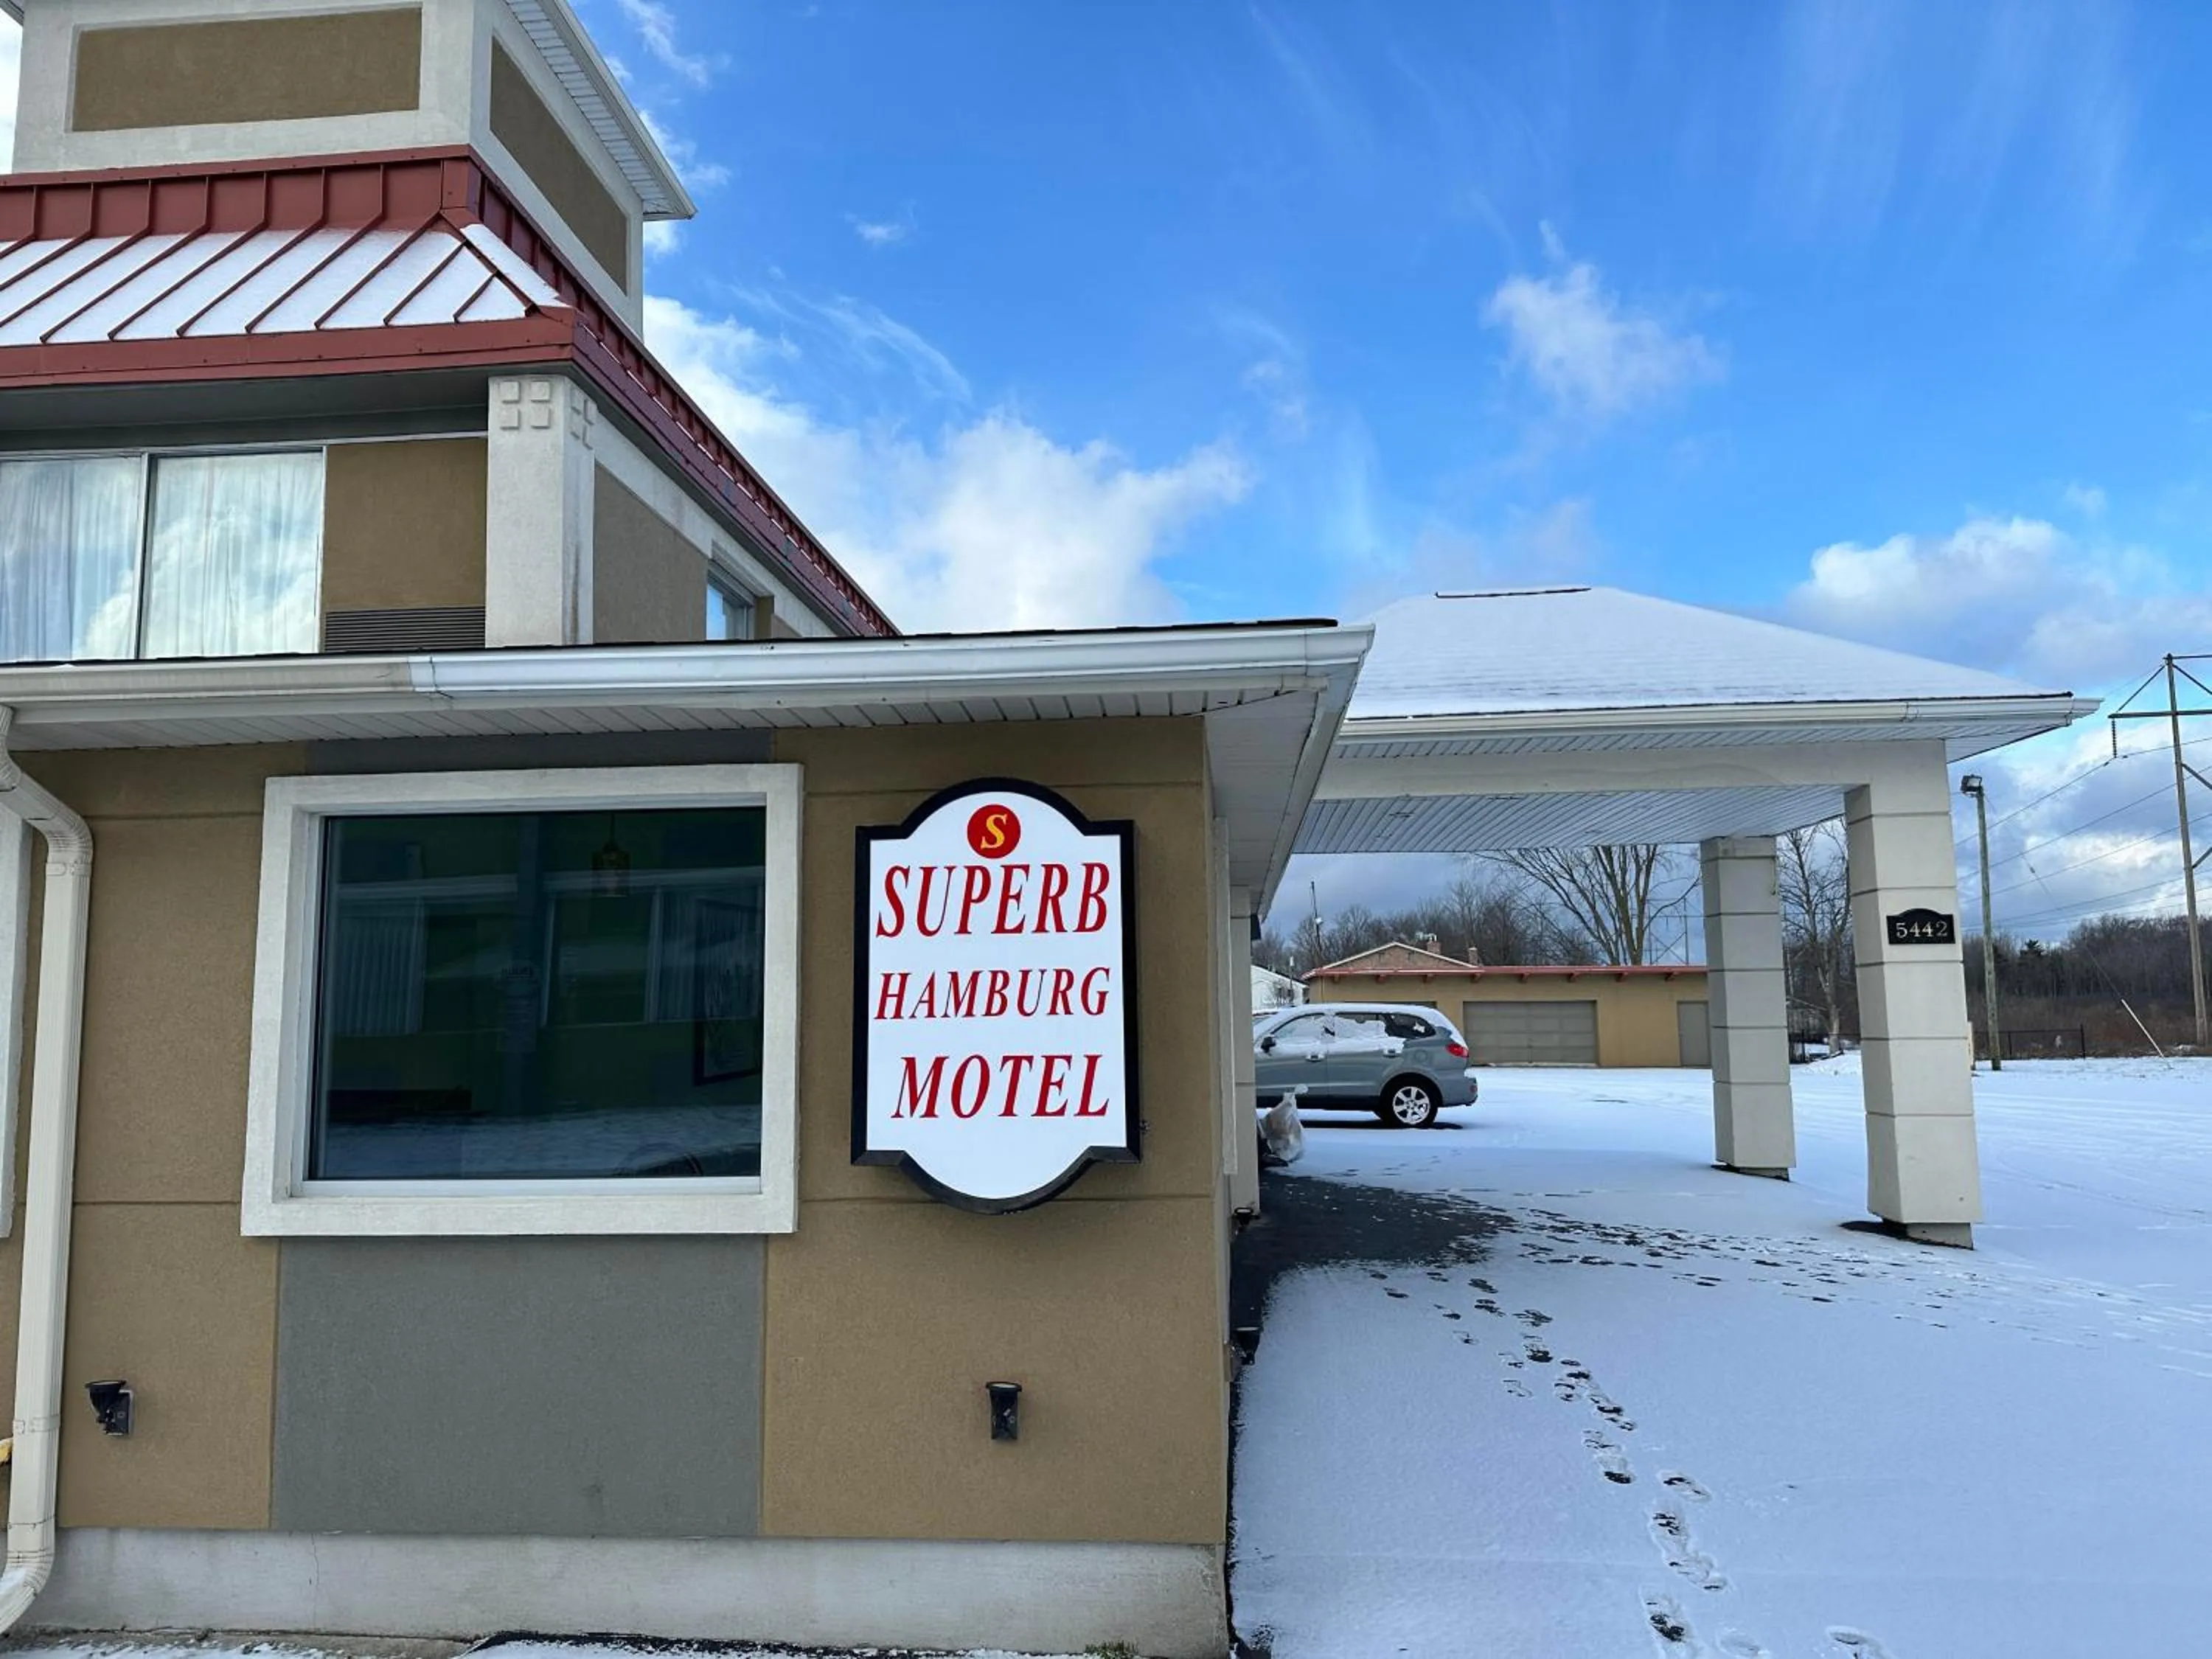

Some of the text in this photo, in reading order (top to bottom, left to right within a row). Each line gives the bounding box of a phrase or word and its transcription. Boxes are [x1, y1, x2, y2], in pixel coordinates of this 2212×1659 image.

[981, 813, 1007, 849] S
[876, 862, 1110, 938] SUPERB
[1895, 920, 1948, 939] 5442
[874, 967, 1110, 1020] HAMBURG
[891, 1054, 1110, 1119] MOTEL
